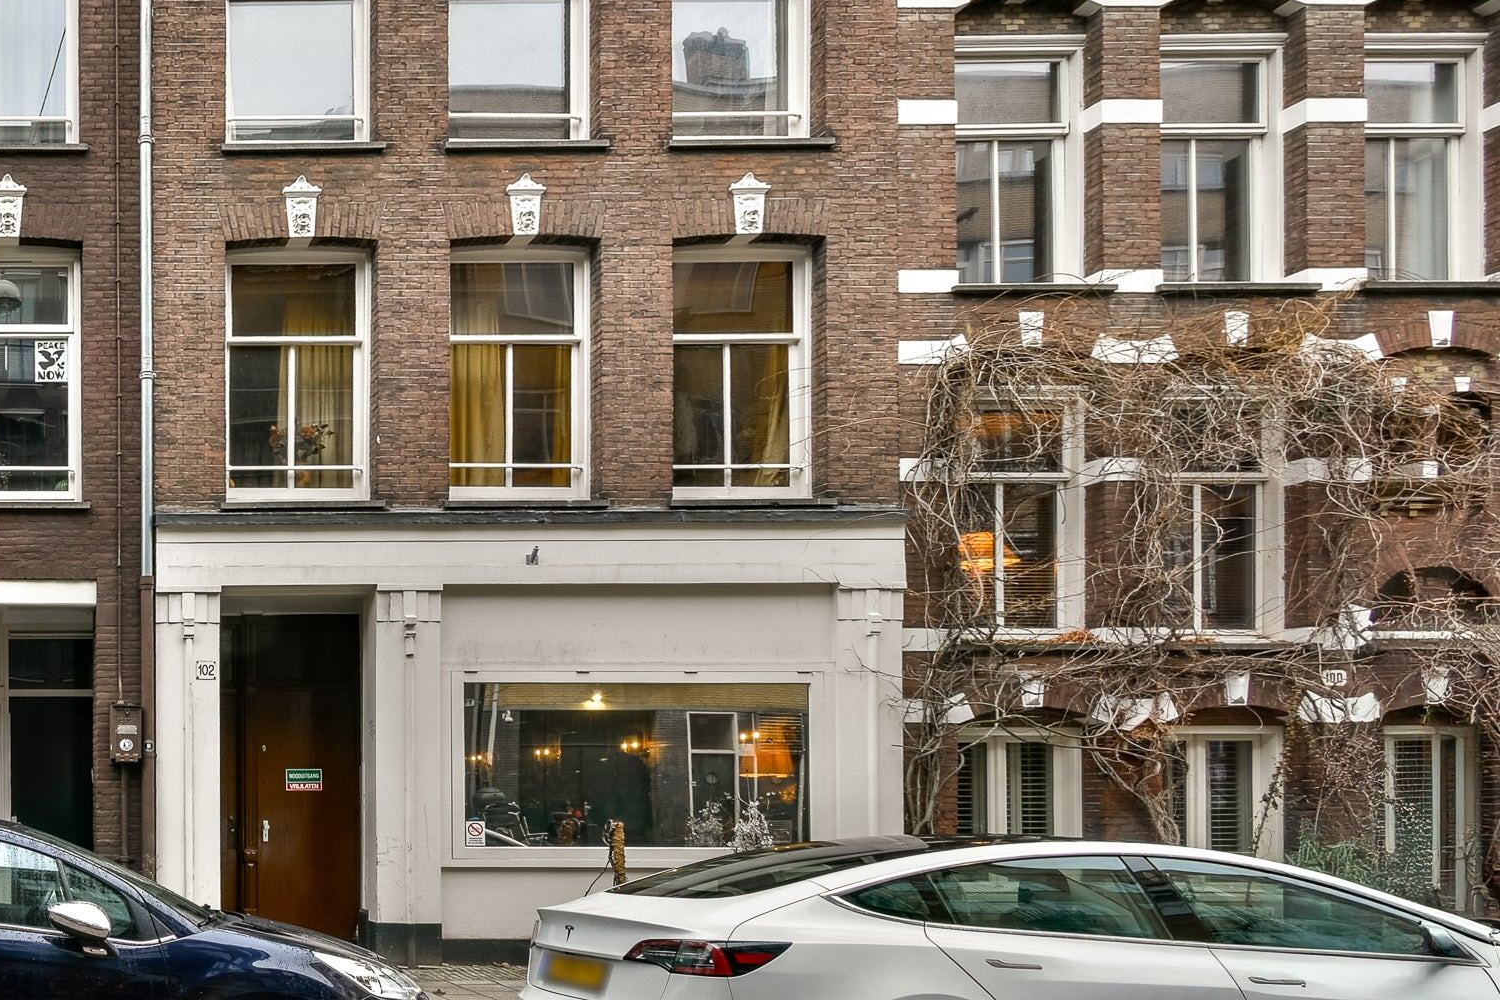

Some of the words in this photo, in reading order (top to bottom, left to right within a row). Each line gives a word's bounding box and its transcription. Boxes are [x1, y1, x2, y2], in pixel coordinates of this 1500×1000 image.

[37, 342, 65, 350] PEACE
[37, 370, 65, 380] NOW
[197, 664, 215, 676] 102
